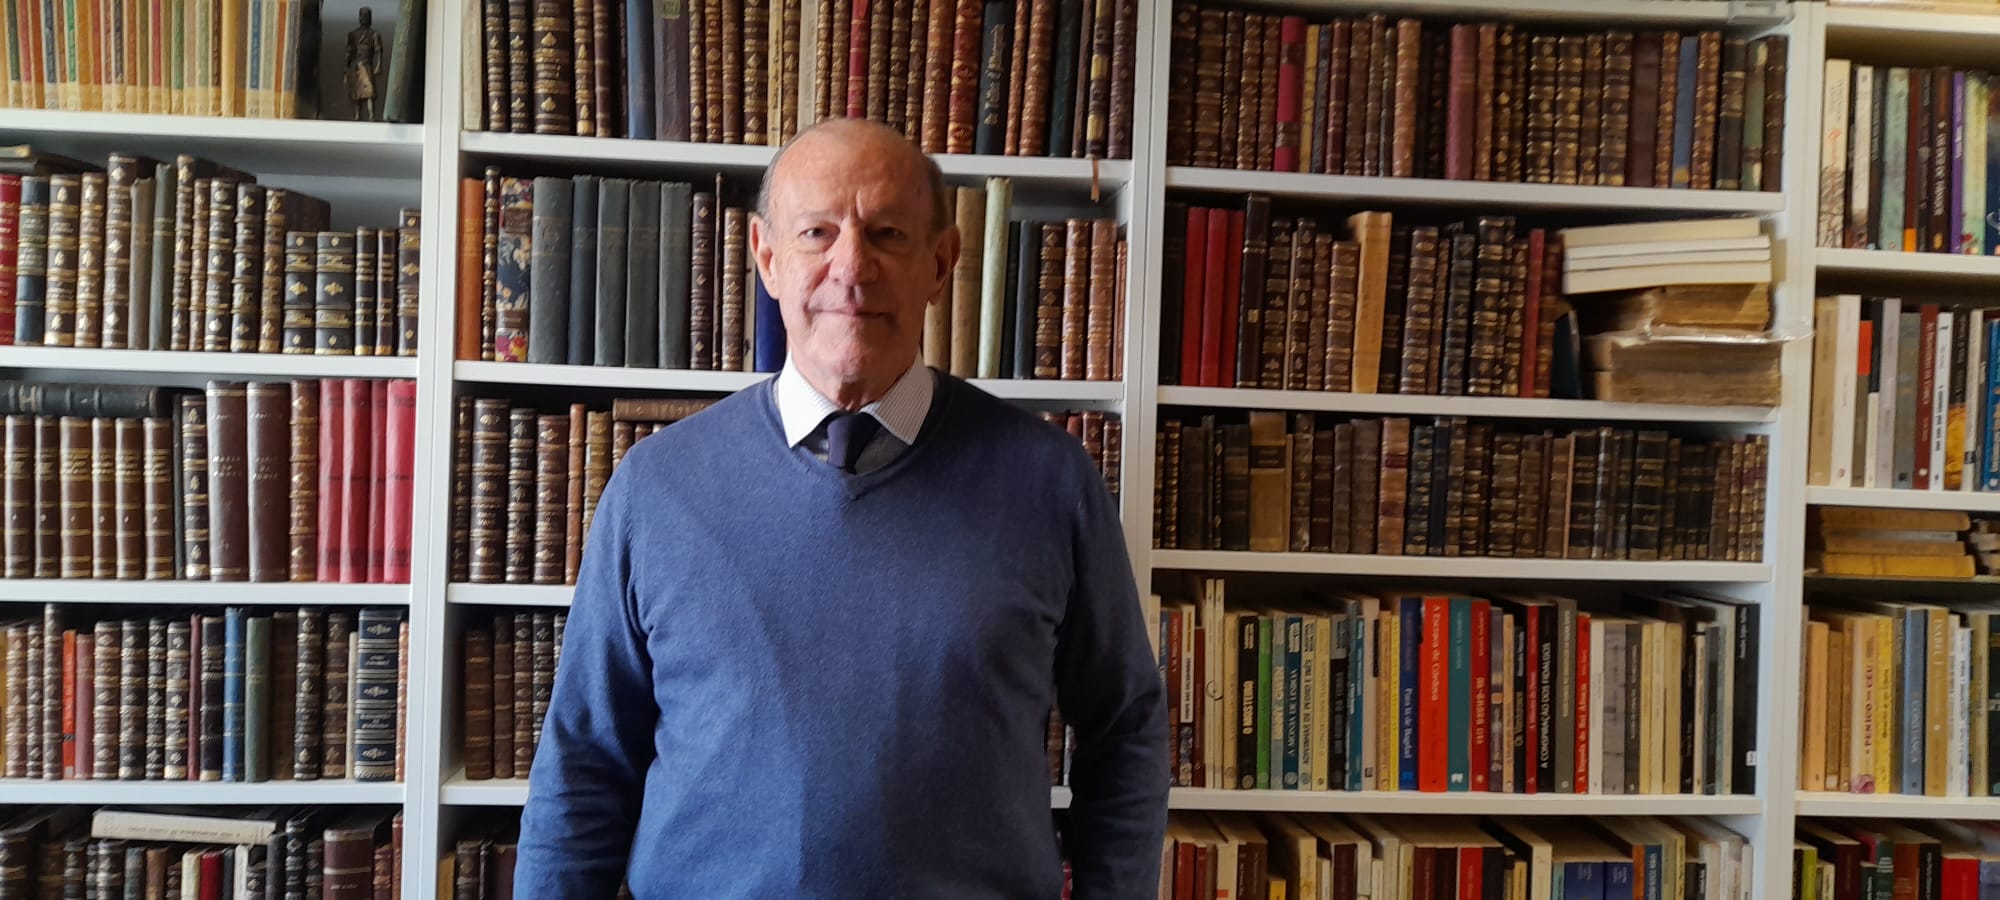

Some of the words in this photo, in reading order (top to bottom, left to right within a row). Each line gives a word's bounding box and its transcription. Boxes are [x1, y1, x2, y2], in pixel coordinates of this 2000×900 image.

[1542, 642, 1552, 683] FIDALGOS
[1242, 680, 1254, 726] MOSTEIRO
[1542, 685, 1550, 702] DOS
[1540, 703, 1551, 760] CONSPIRAÇÃO
[1864, 704, 1872, 746] PENICO
